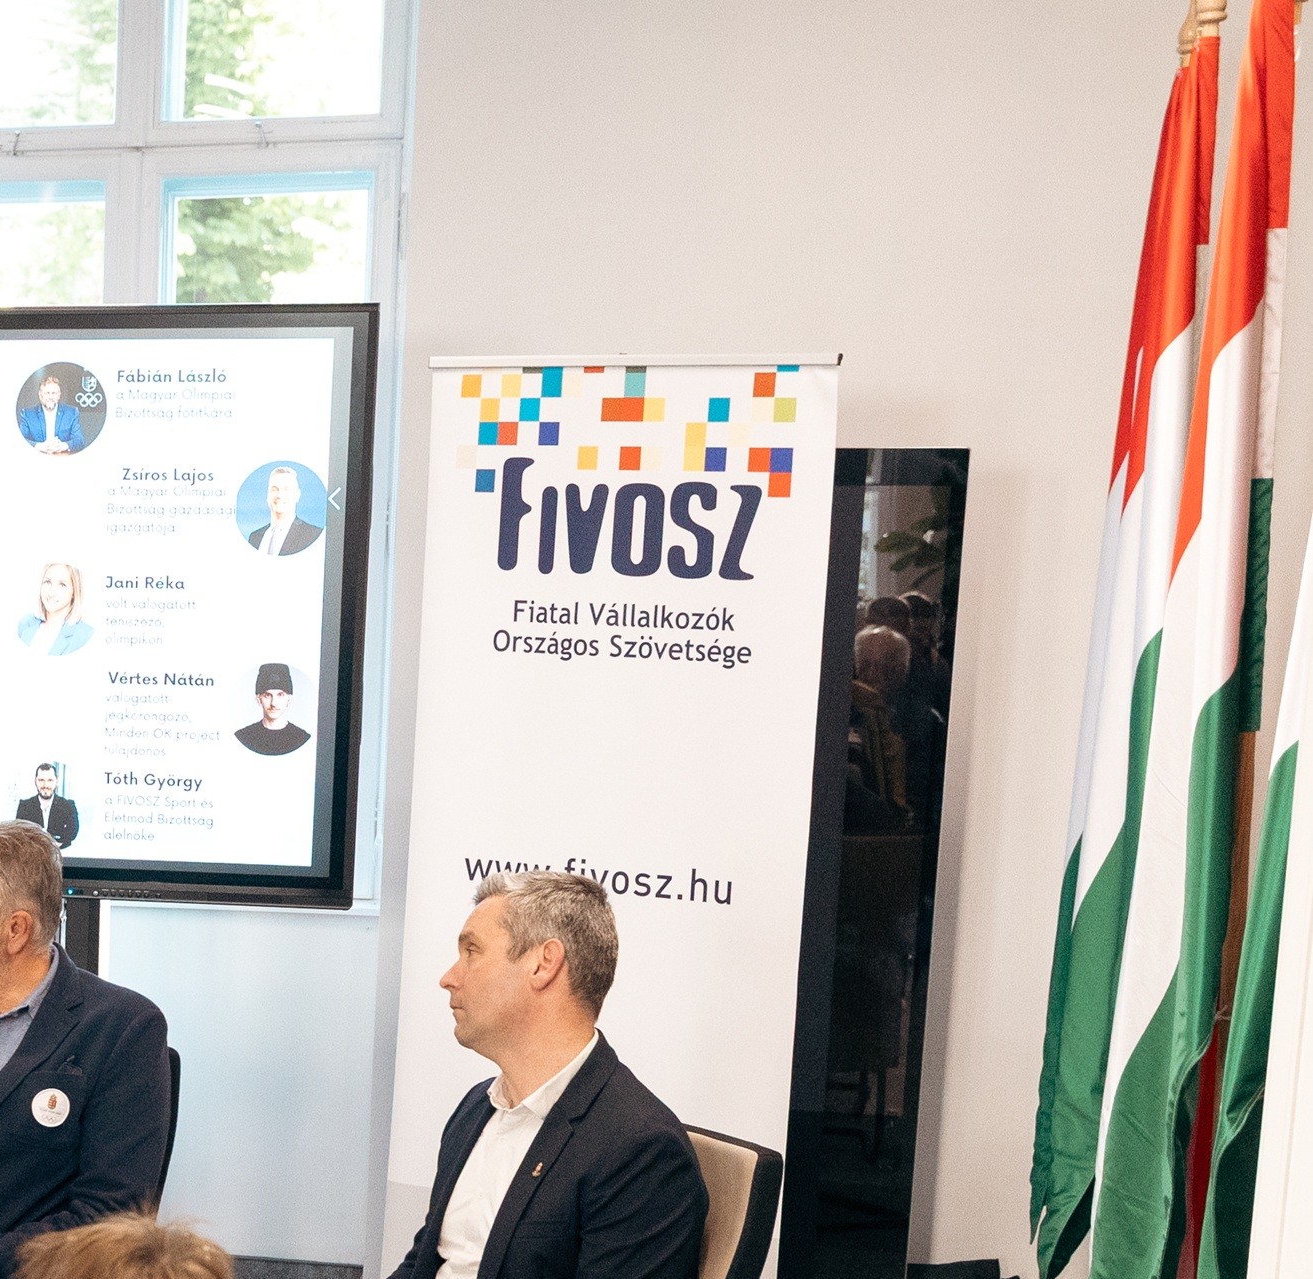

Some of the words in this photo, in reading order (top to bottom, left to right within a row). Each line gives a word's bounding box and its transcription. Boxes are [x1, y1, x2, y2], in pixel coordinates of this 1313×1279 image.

[116, 368, 172, 383] Fábián
[178, 368, 227, 383] László
[122, 467, 168, 481] Zsíros
[173, 468, 214, 485] Lajos
[105, 576, 139, 589] Jani
[145, 575, 185, 590] Réka
[513, 599, 580, 625] Fiatal
[589, 602, 735, 631] Vállalkozók
[493, 629, 599, 661] Országos
[609, 634, 752, 669] Szövetsége
[108, 671, 159, 685] Vértes
[164, 672, 215, 687] Nátán
[104, 771, 138, 785] Tóth
[144, 773, 203, 792] György
